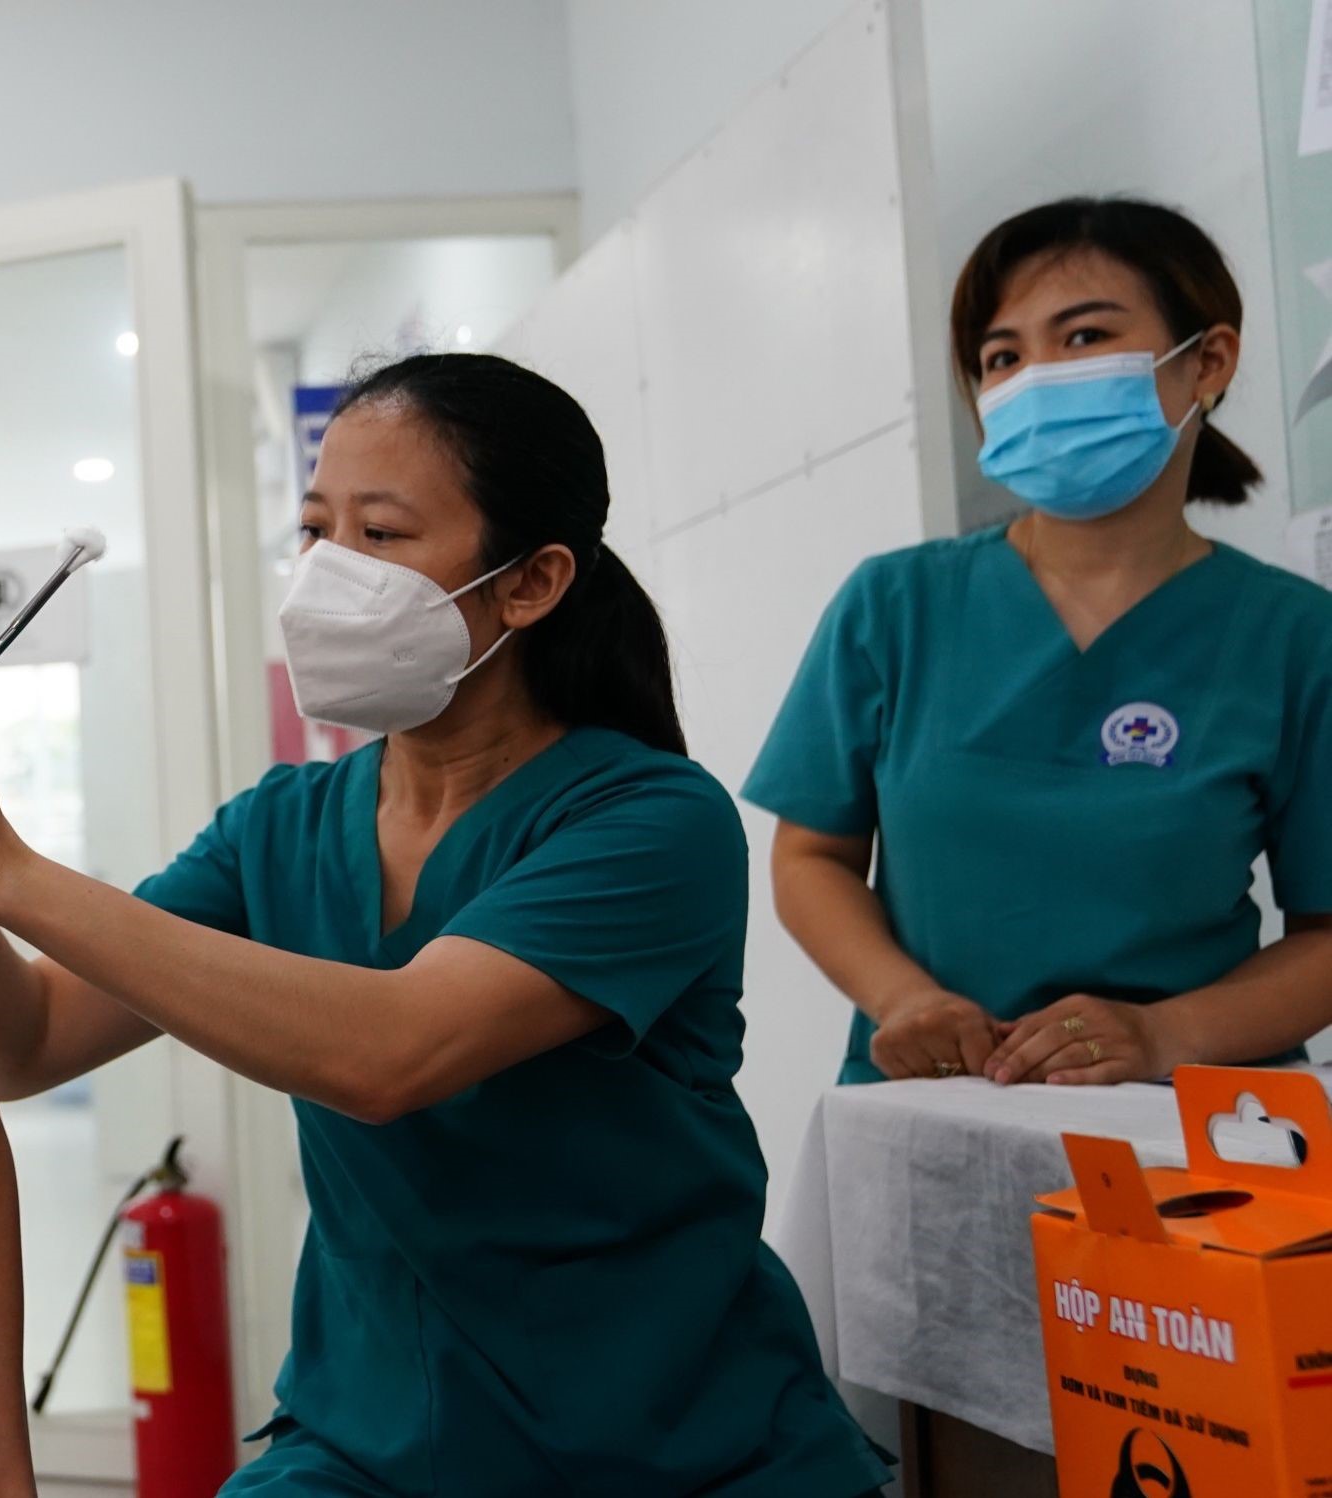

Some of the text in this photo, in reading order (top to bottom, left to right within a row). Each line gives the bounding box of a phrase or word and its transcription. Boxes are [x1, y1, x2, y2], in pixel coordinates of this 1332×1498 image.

[1053, 1278, 1236, 1363] HỘP AN TOÀN
[1103, 1390, 1127, 1411] KIM
